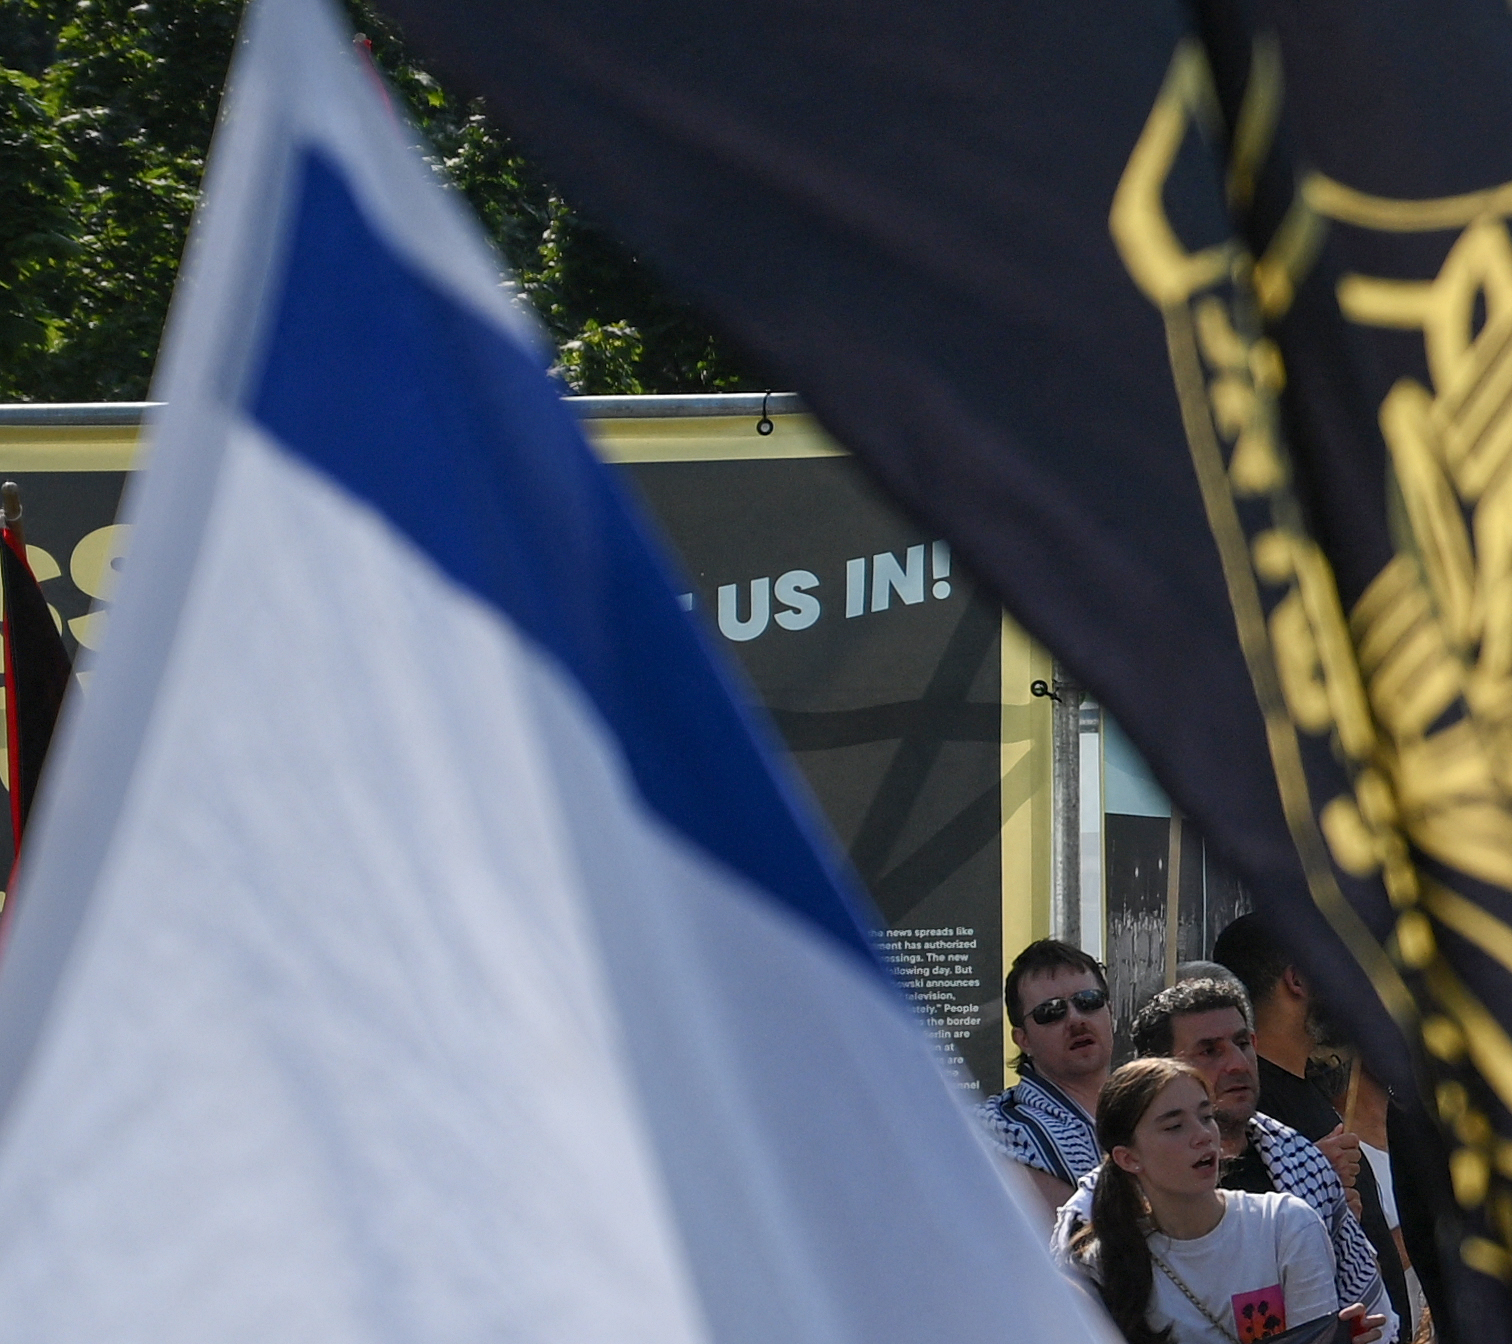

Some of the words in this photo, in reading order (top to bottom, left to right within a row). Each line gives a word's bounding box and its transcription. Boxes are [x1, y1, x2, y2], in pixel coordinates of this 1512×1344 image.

[717, 569, 821, 643] US
[845, 539, 951, 619] IN!
[886, 929, 912, 937] news
[914, 926, 954, 939] spreads
[955, 926, 974, 936] like
[904, 940, 922, 950] has
[923, 939, 977, 949] authorized
[925, 952, 946, 962] The
[947, 954, 969, 962] new
[931, 966, 953, 976] day.
[954, 965, 973, 974] But
[925, 979, 980, 988] announces
[943, 1004, 980, 1014] People
[926, 1016, 945, 1026] the
[946, 1016, 981, 1026] border
[953, 1030, 971, 1038] are
